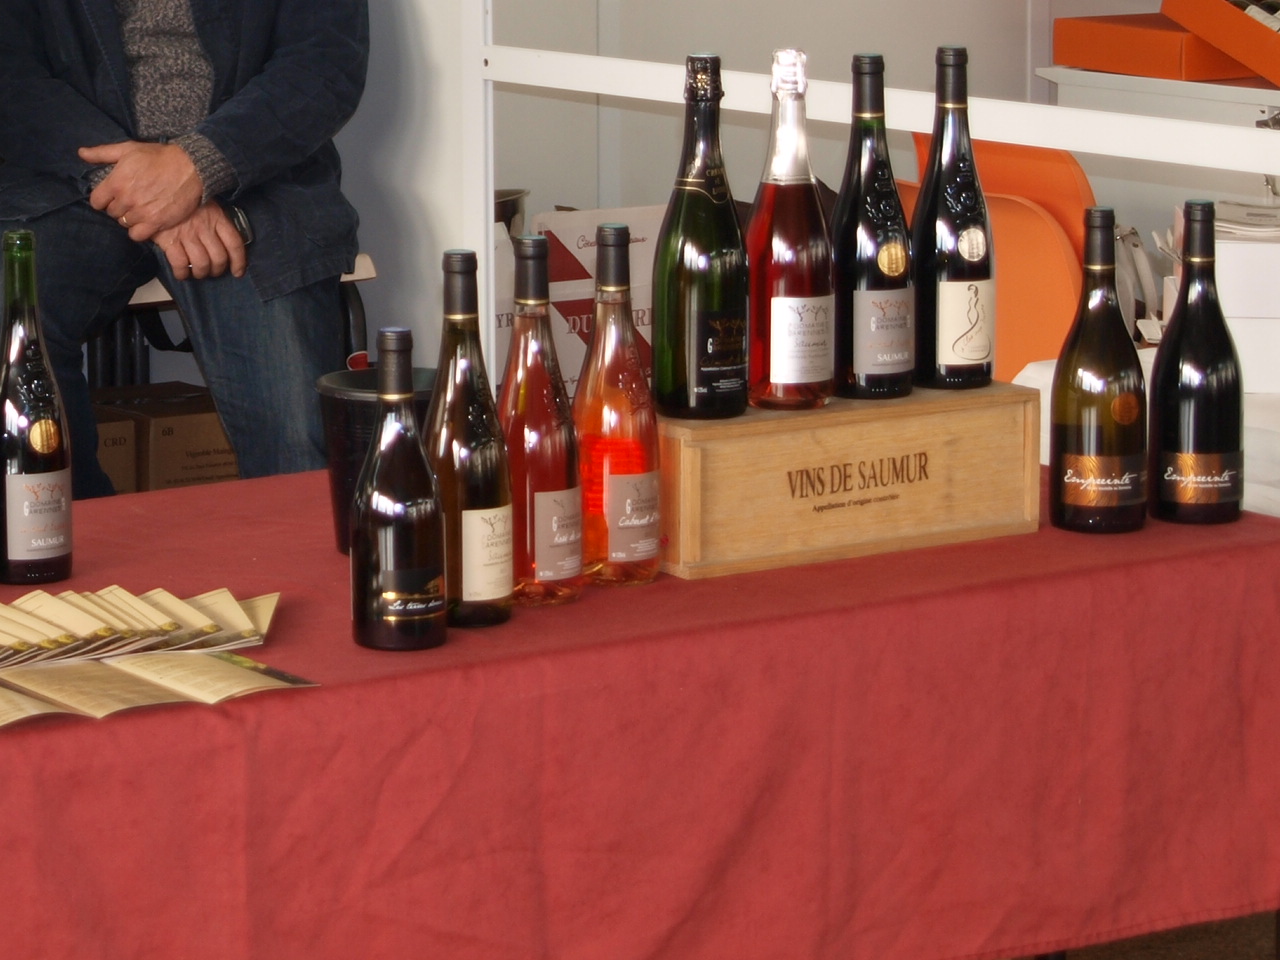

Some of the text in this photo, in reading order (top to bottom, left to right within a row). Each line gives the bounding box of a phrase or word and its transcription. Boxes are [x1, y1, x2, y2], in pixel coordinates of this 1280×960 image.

[787, 451, 930, 499] VINS DE SAUMUR
